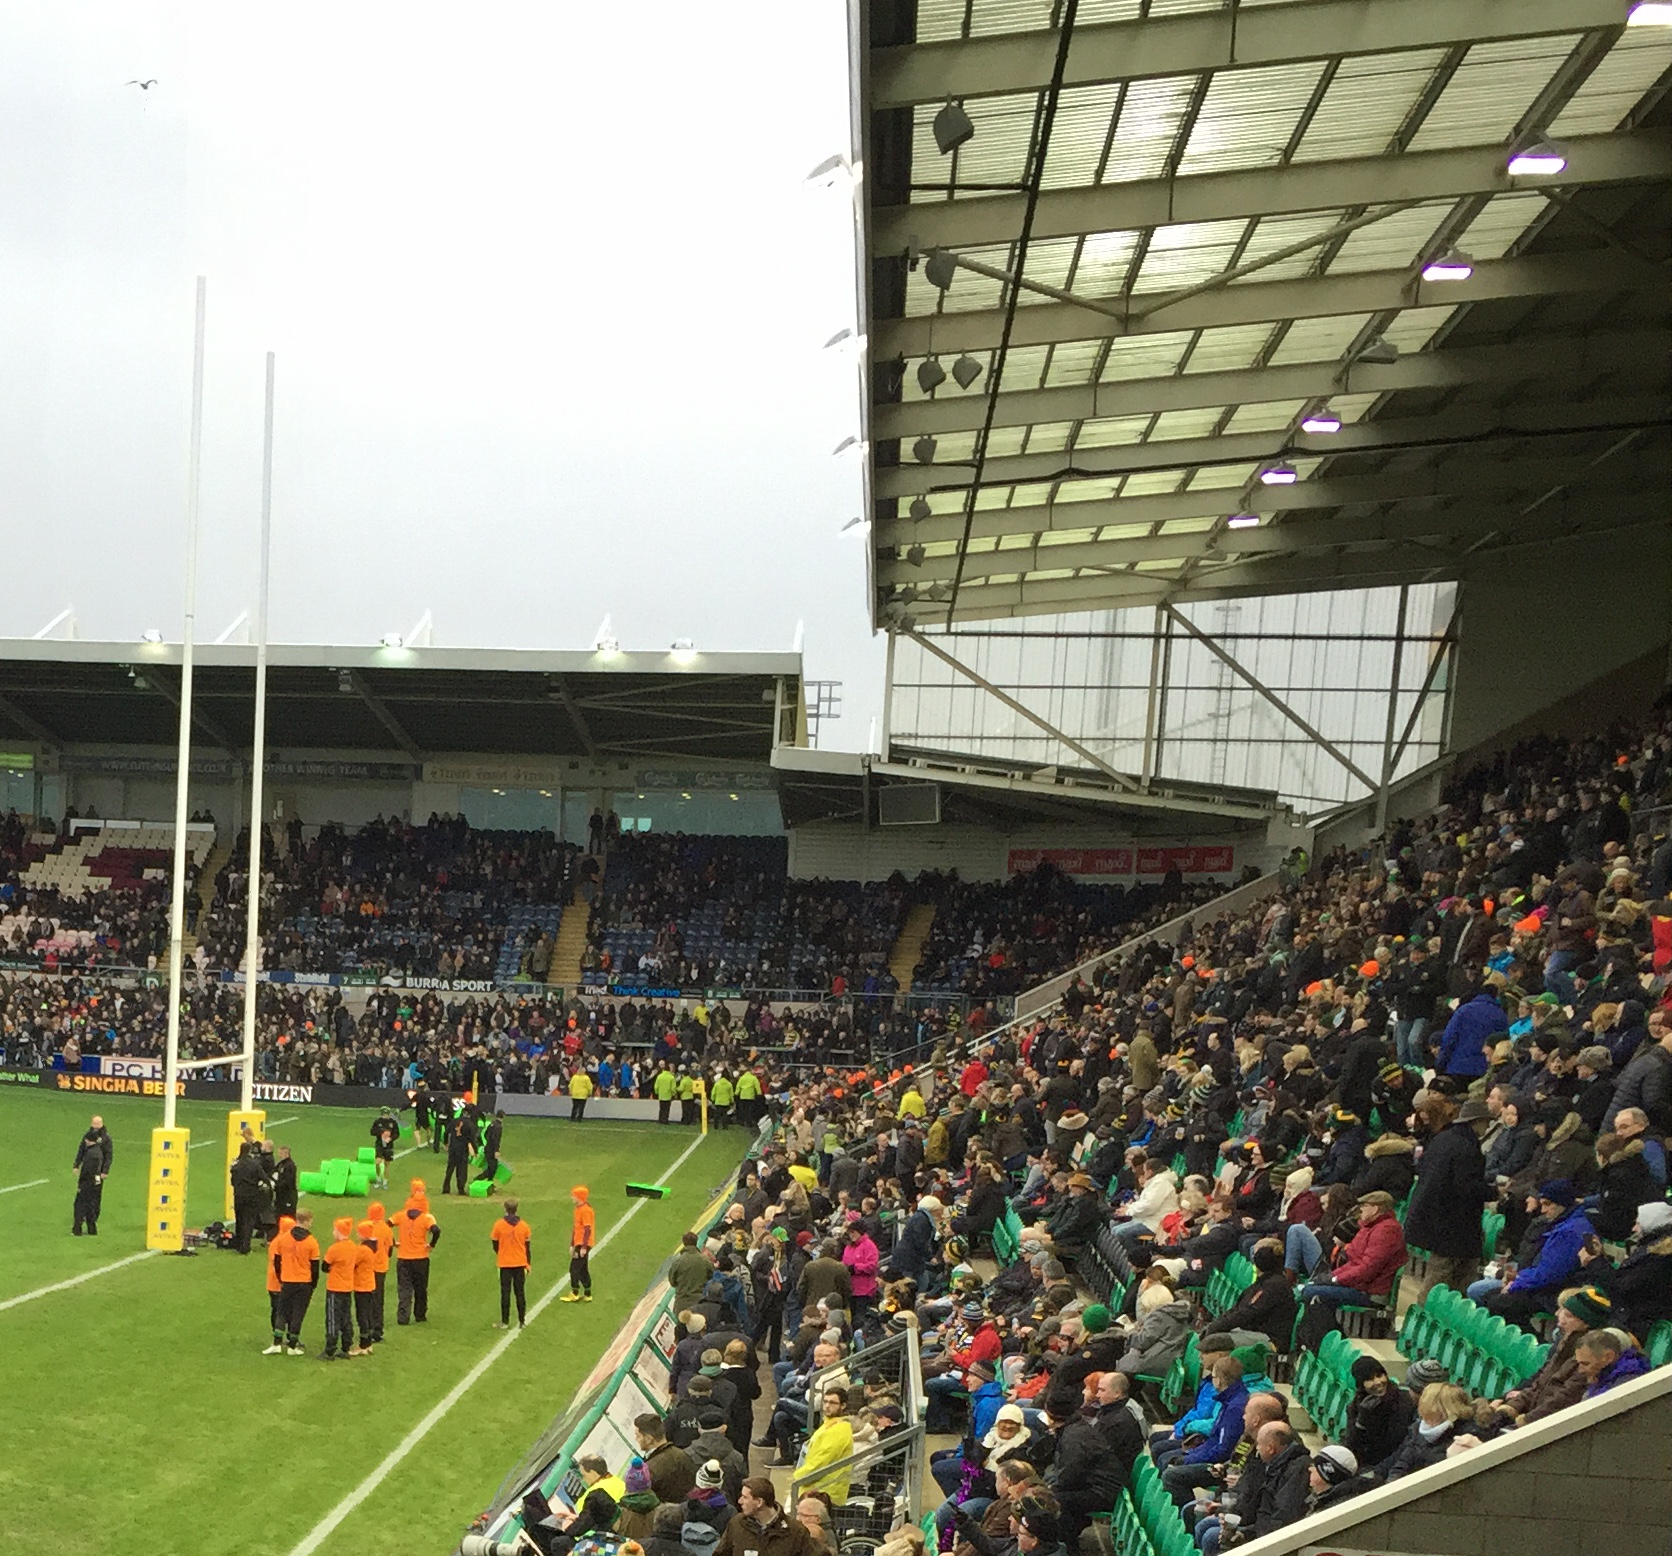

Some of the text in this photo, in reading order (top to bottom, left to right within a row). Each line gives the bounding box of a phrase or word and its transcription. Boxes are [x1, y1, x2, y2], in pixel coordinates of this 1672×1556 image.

[453, 980, 494, 992] SPORT
[613, 986, 639, 996] Think
[641, 987, 681, 998] Creative
[17, 1072, 40, 1084] What
[73, 1074, 186, 1097] SINGHA BER
[252, 1084, 313, 1102] CITIZEN
